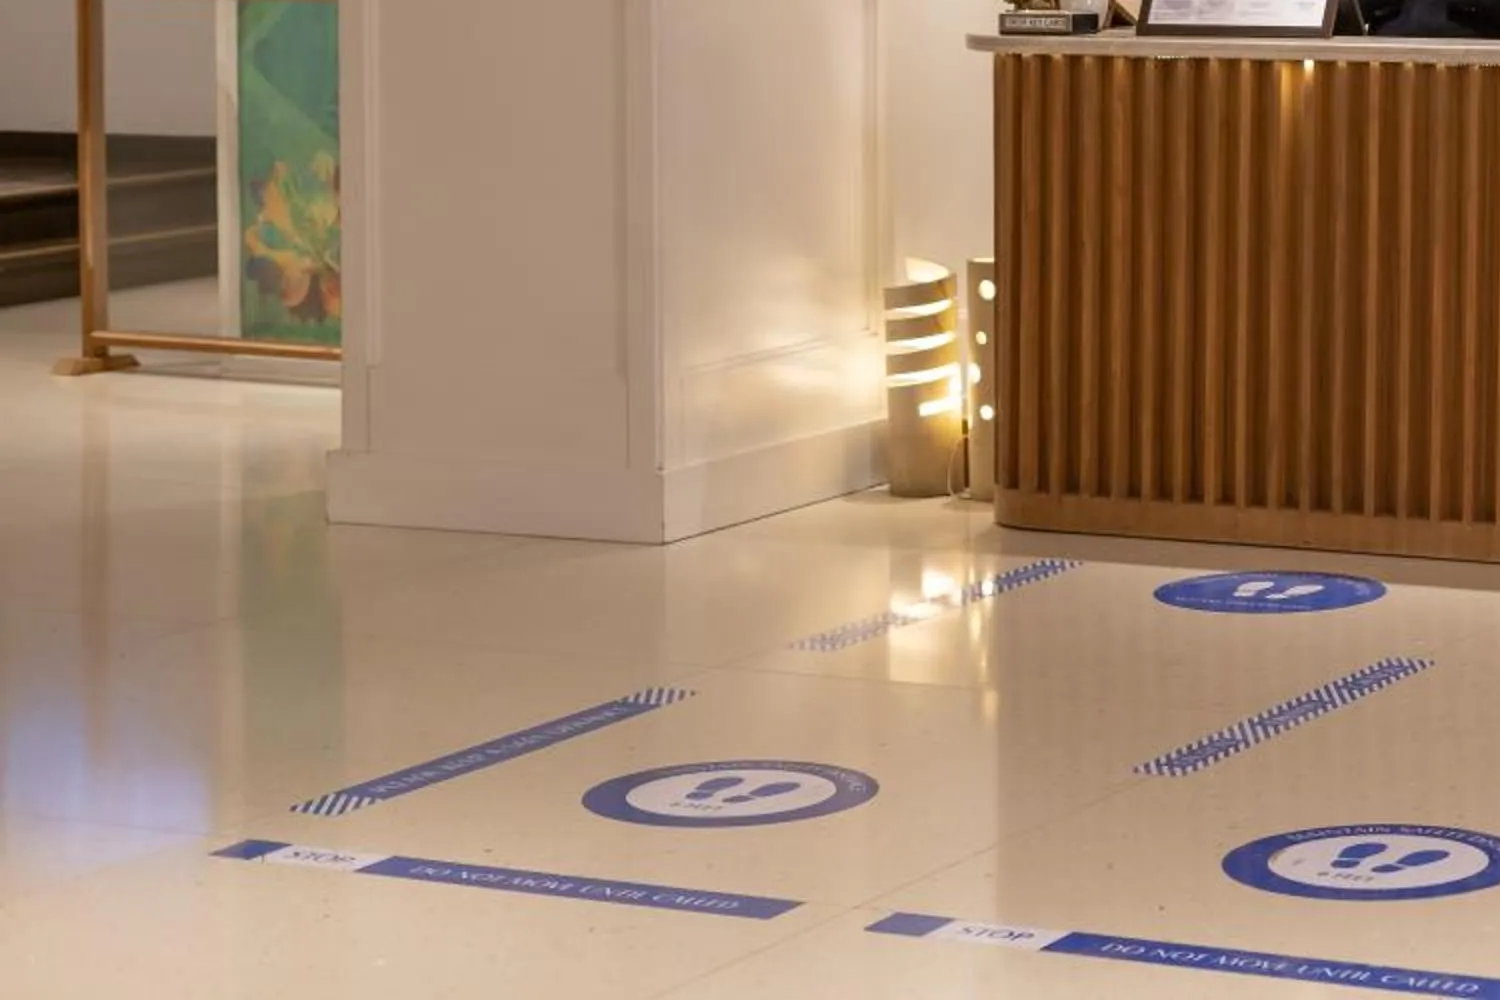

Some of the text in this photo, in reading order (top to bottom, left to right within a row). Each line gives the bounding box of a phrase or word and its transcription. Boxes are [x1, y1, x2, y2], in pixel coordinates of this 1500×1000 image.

[409, 865, 742, 909] DO NOT MOVE UNTIL CALLED
[958, 926, 1036, 941] STOP
[1100, 942, 1481, 993] DO NOT MOVE UNTIL CALLED
